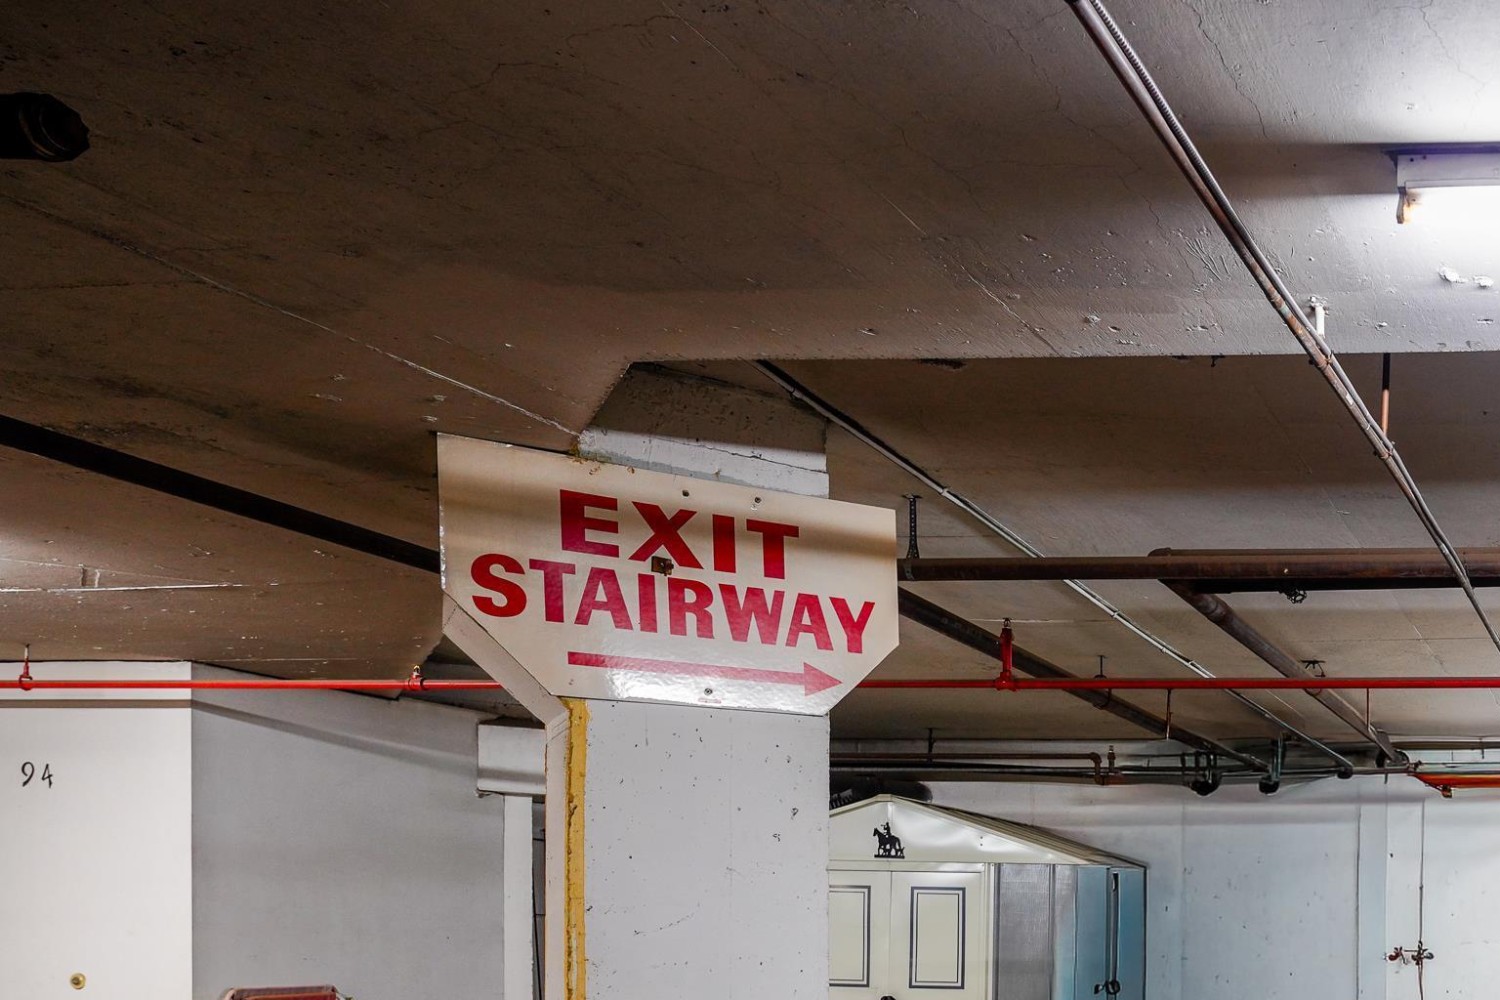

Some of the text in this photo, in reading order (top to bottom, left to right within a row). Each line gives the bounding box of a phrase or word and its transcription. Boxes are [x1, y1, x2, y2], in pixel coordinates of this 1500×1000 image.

[560, 489, 800, 580] EXIT
[470, 553, 876, 654] STAIRWAY
[21, 761, 54, 789] 94
